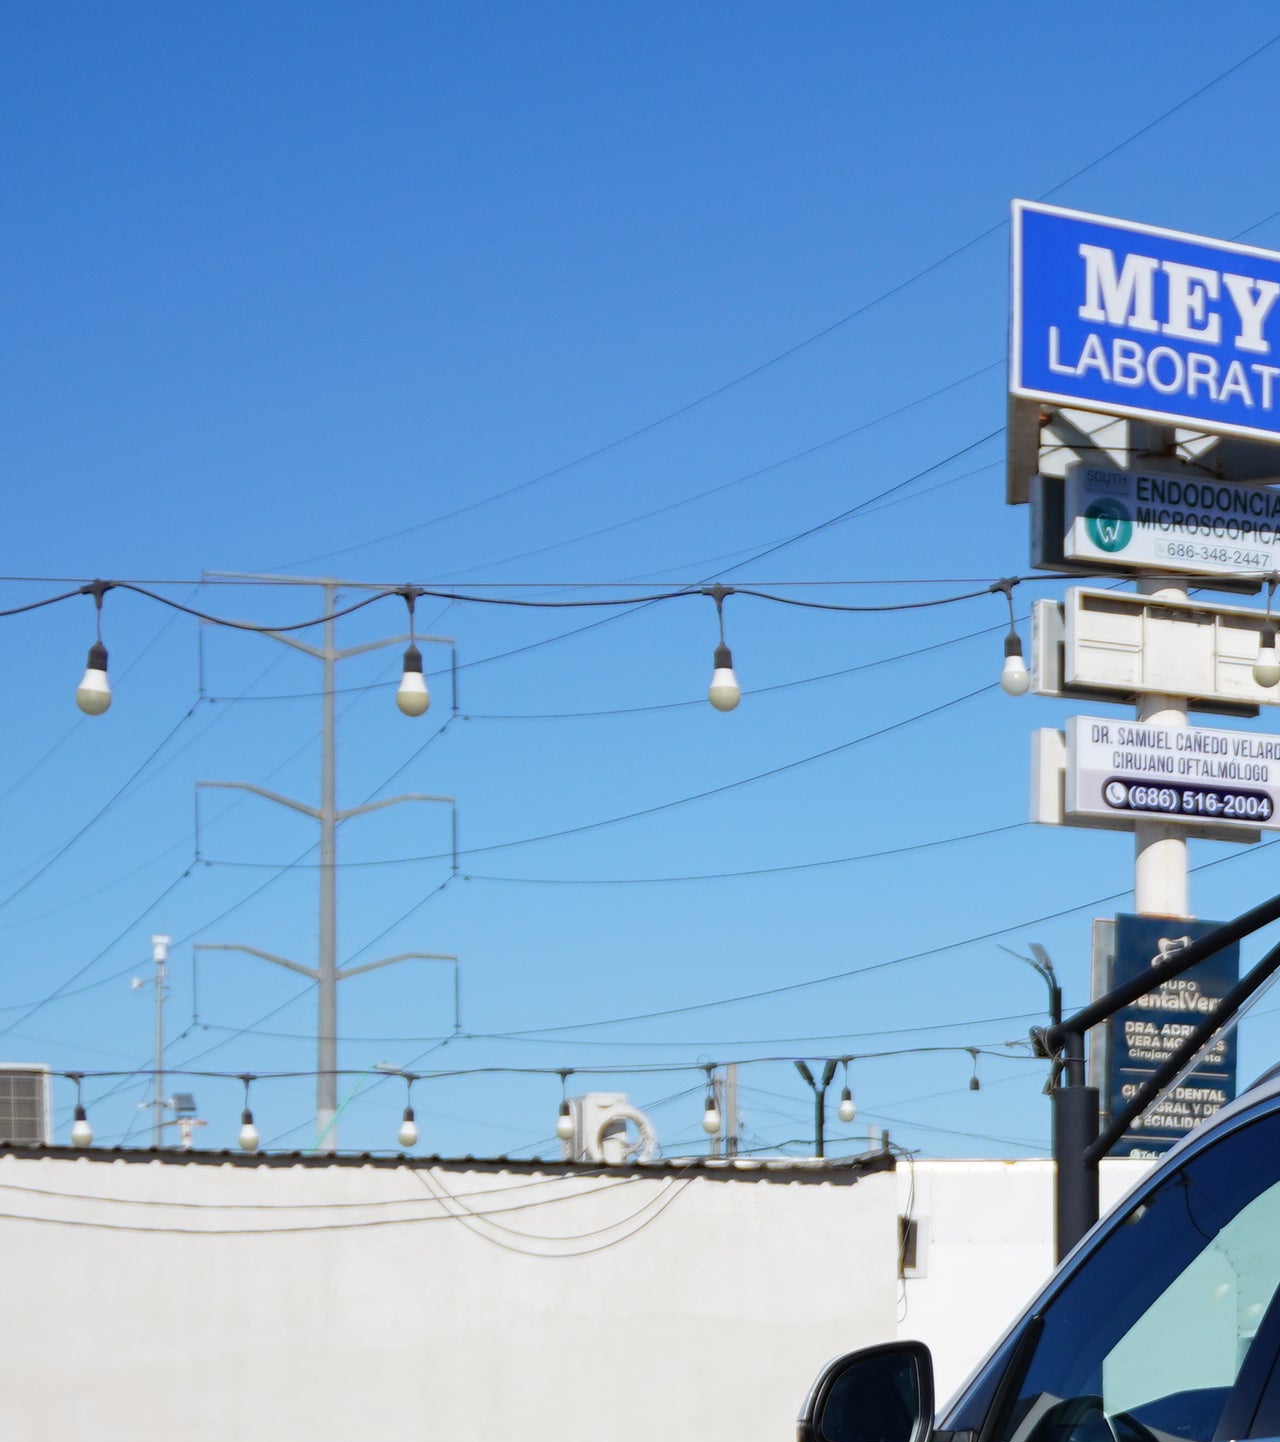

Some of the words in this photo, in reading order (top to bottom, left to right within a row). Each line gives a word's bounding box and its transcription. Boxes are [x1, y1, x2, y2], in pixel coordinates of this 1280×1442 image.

[1167, 541, 1270, 568] 686-348-2447
[1091, 724, 1113, 744] DR.
[1118, 727, 1172, 750] SAMUEL
[1176, 731, 1228, 756] CAÑEDO
[1112, 750, 1174, 774] CIRUJANO
[1177, 757, 1269, 783] OFTALMÓLOGO
[1128, 785, 1177, 810] (686)
[1182, 790, 1270, 818] 516-2004
[1128, 989, 1222, 1012] entalVer
[1126, 1035, 1160, 1048] VERA
[1128, 1048, 1172, 1060] Cirujan
[1175, 1088, 1226, 1101] DENTAL
